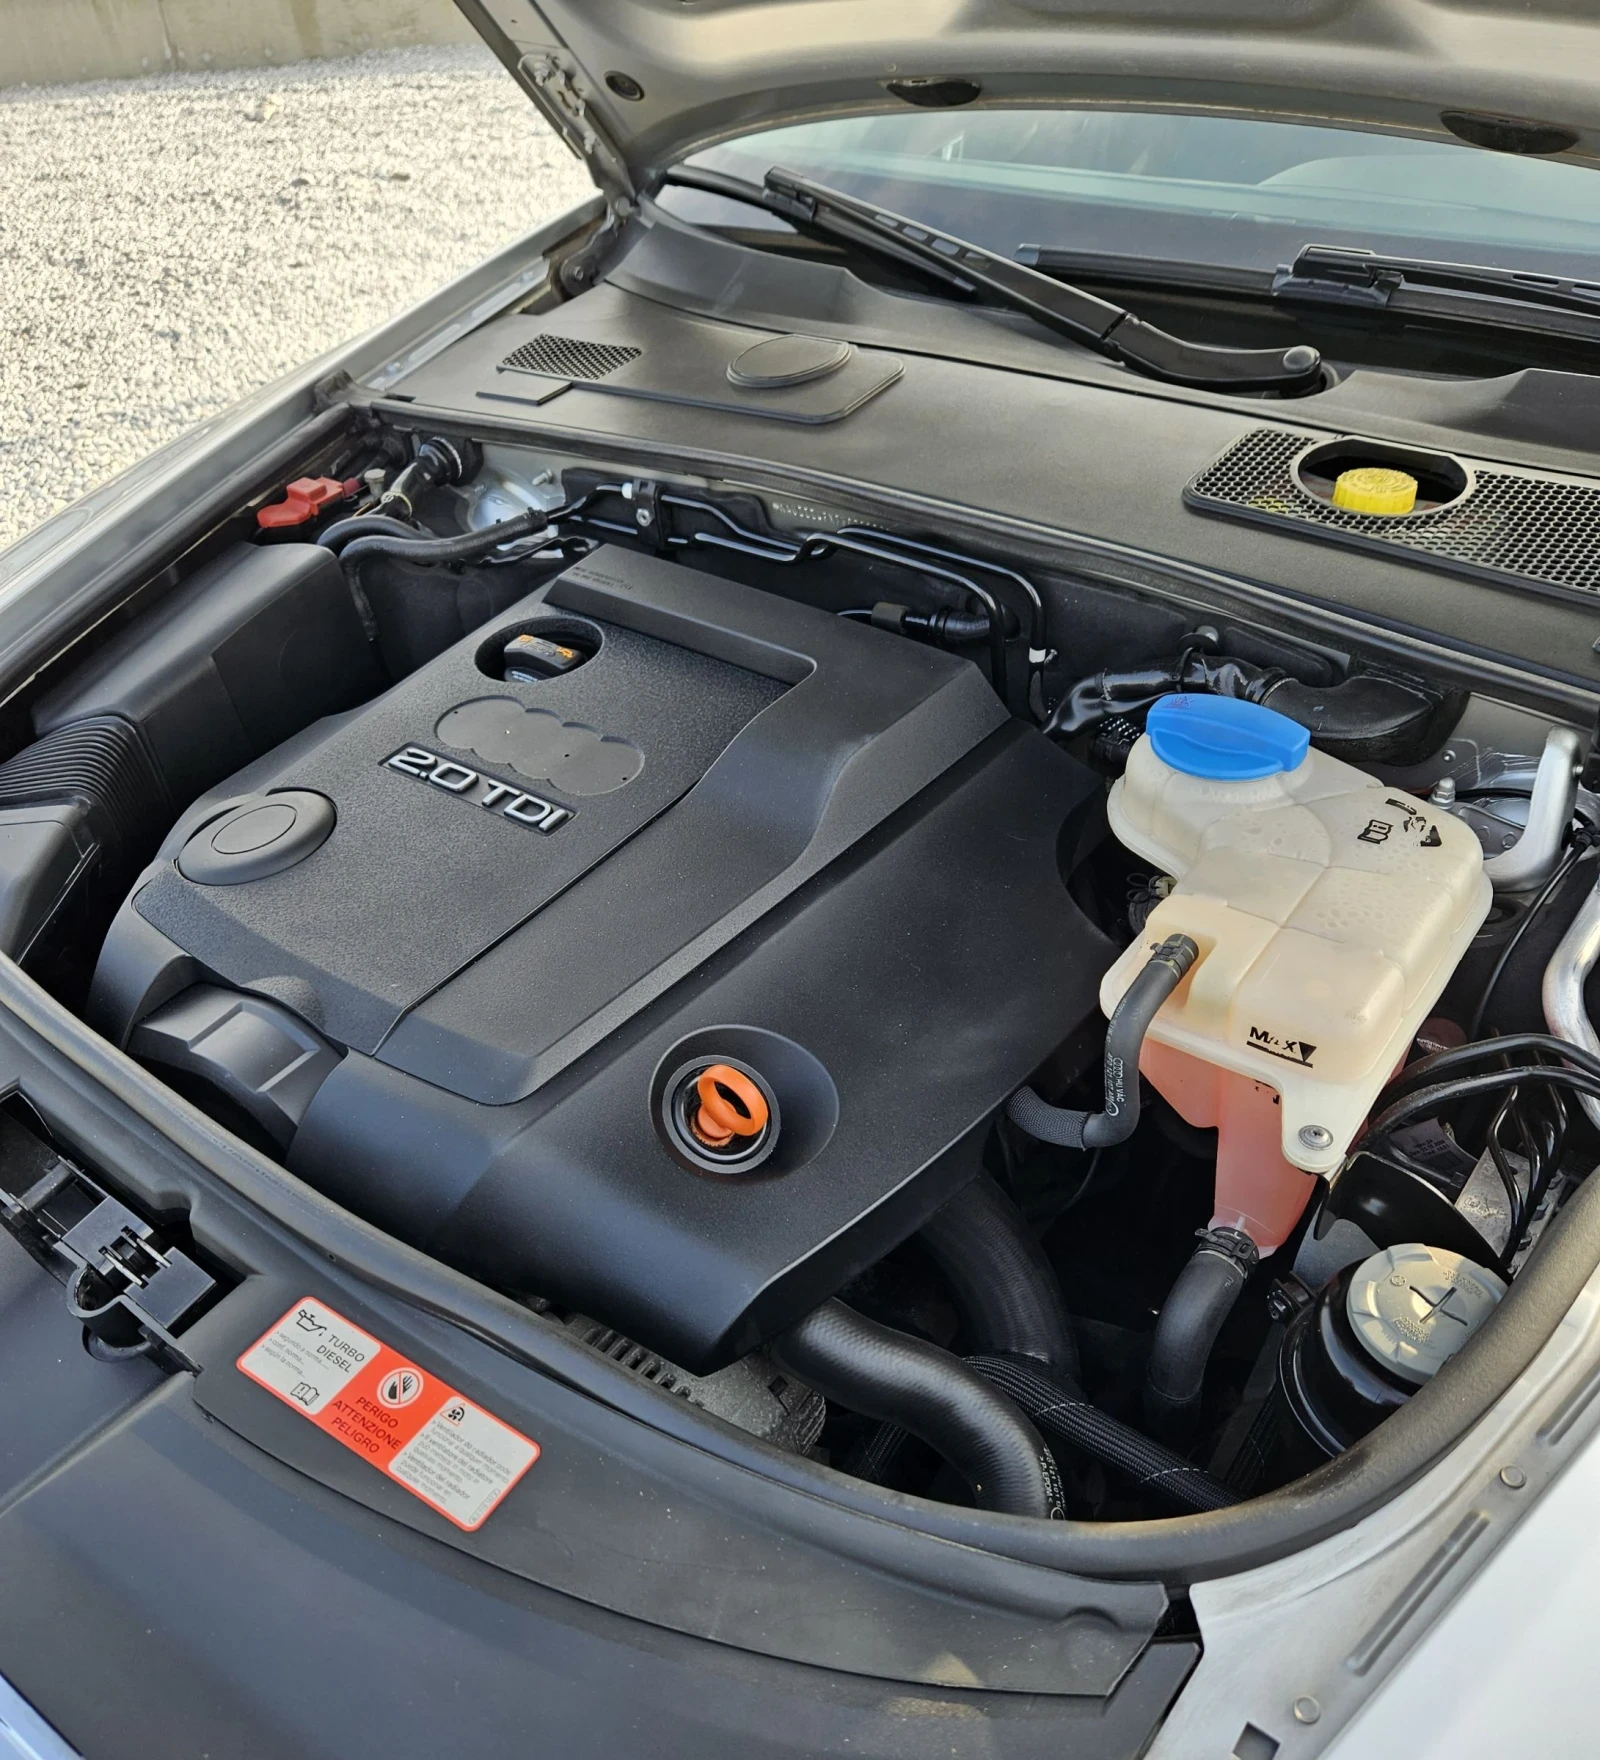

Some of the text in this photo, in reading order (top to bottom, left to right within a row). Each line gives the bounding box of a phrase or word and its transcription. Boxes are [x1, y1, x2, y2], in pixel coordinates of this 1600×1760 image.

[388, 748, 569, 832] 2.0 TDI
[316, 1344, 353, 1373] DIESEL
[328, 1334, 365, 1363] TURBO
[332, 1399, 403, 1451] ATTENZIONE
[355, 1396, 399, 1429] PERIGO
[331, 1416, 380, 1454] PELIGRO
[435, 1421, 465, 1443] Ventilador
